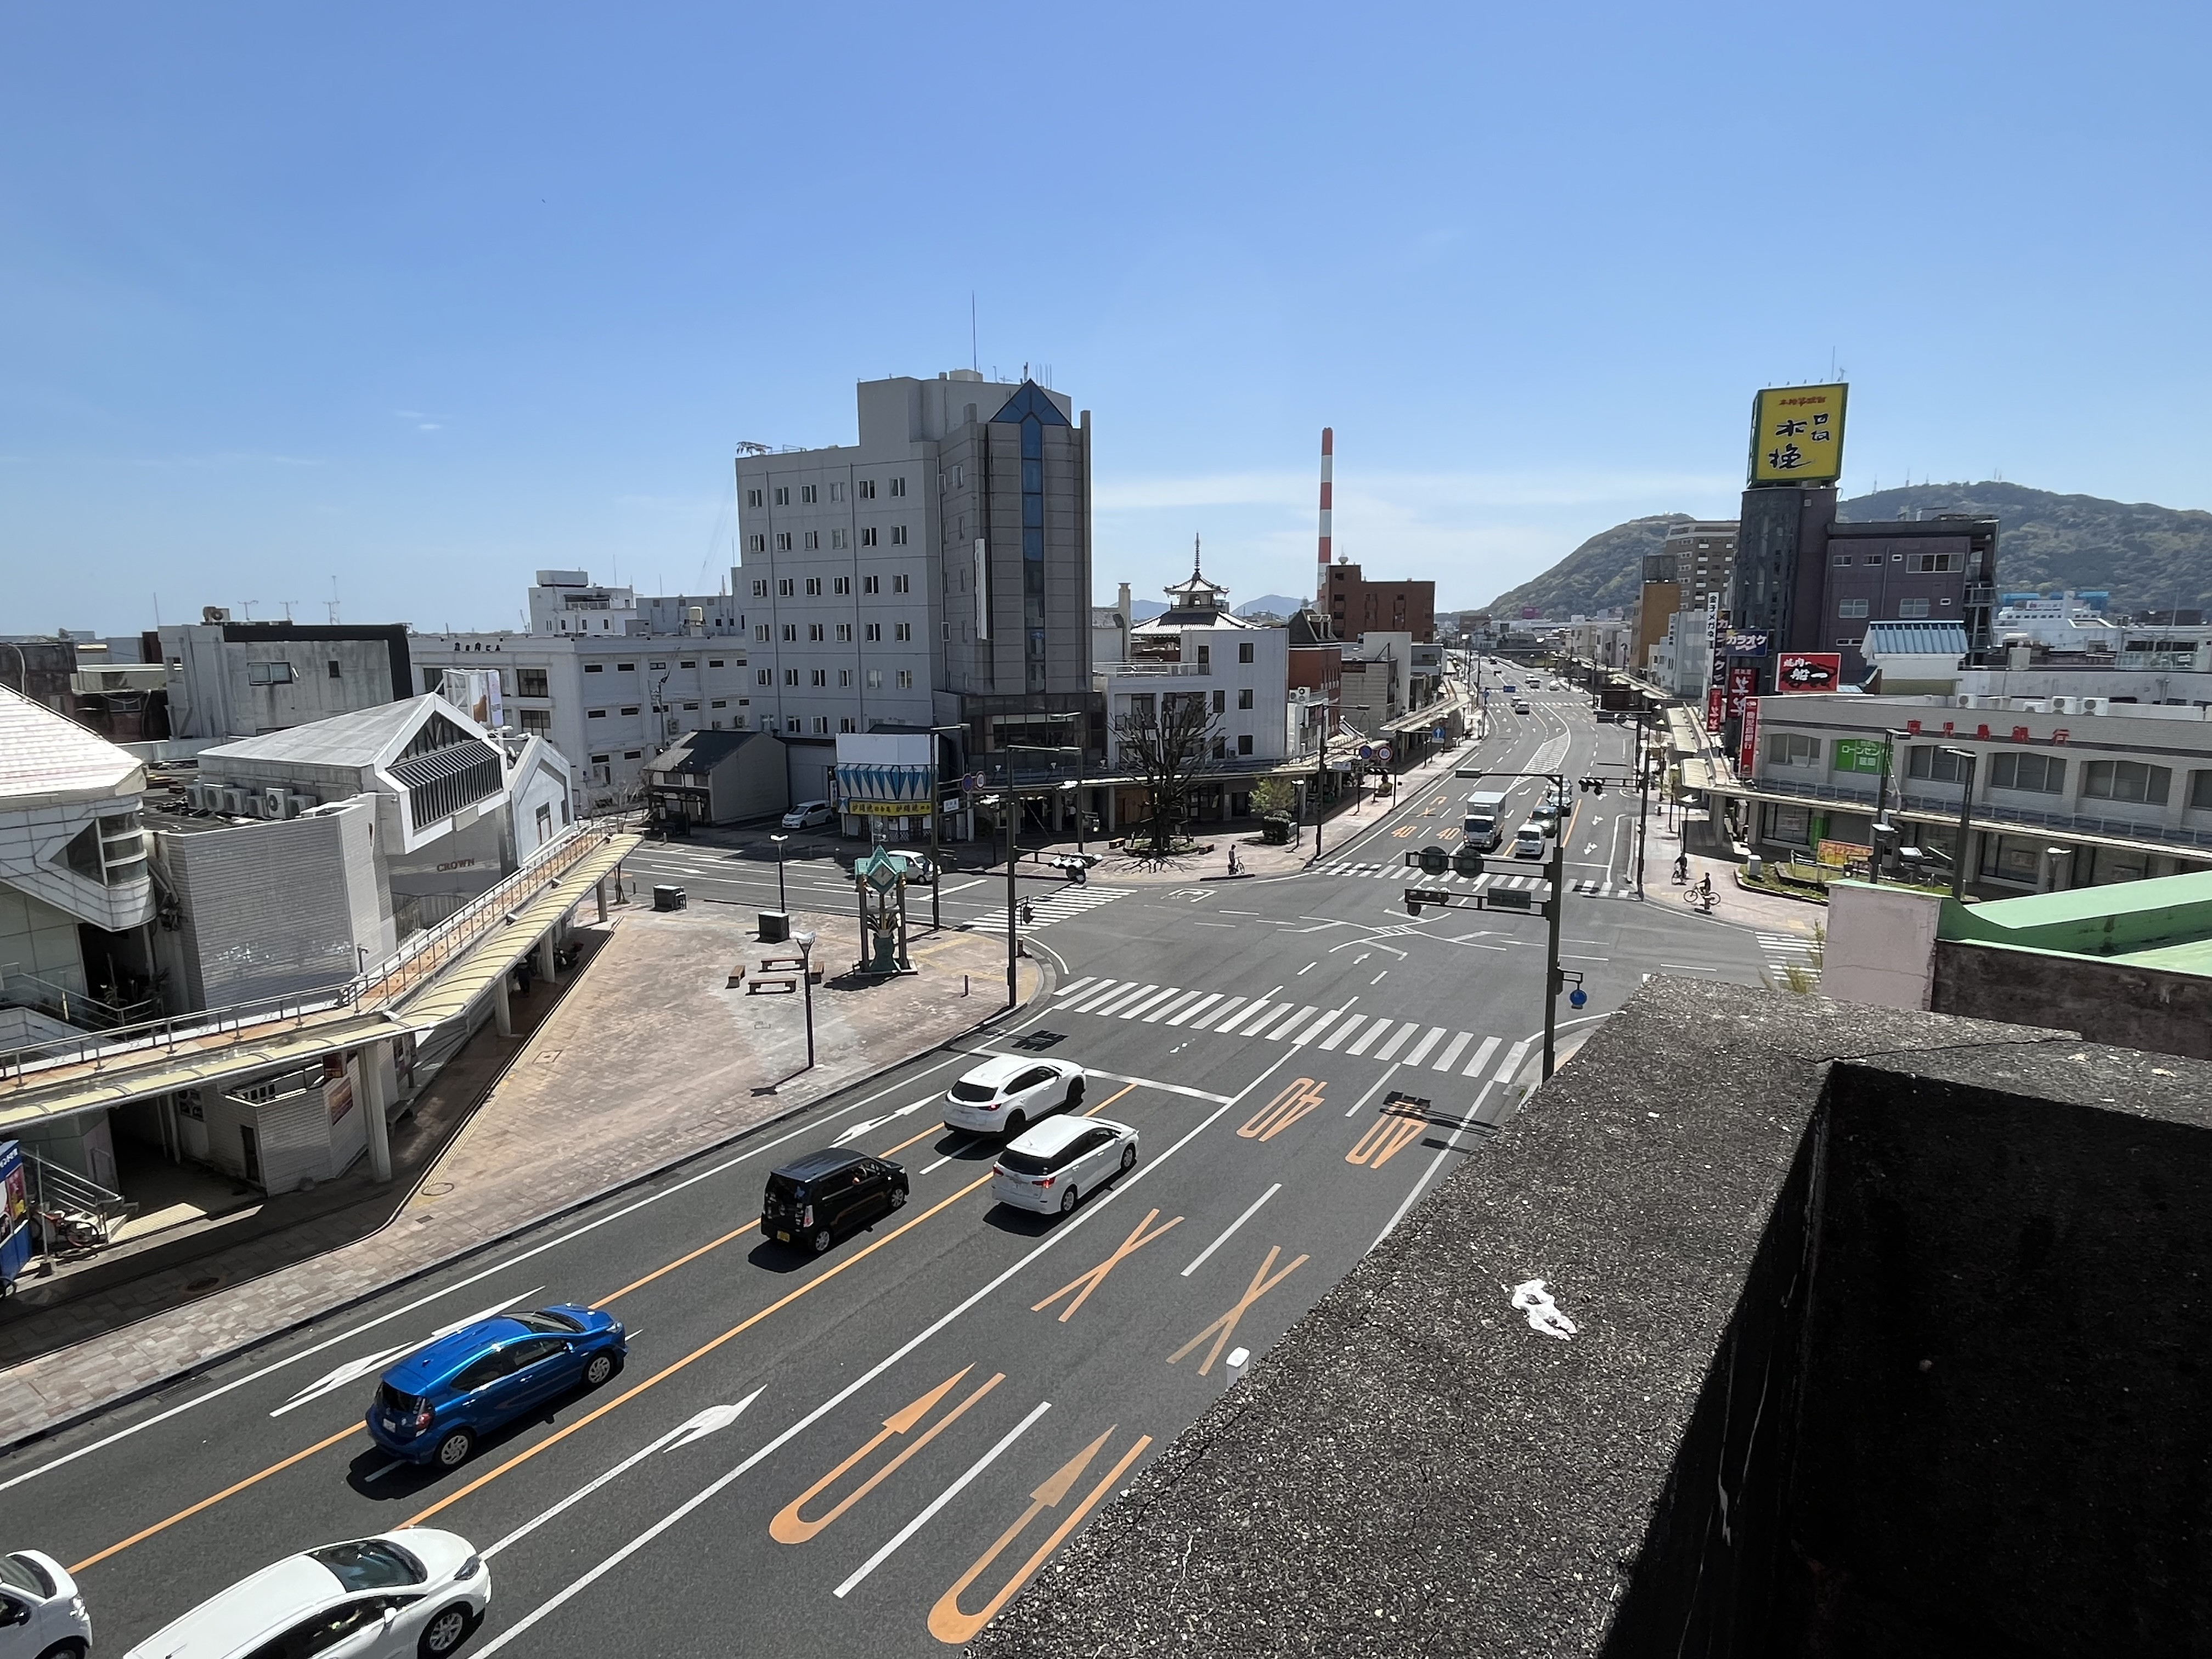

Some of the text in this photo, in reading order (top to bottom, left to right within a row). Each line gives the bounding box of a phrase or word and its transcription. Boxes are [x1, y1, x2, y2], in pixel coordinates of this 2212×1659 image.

[1811, 413, 1830, 441] 日向
[1726, 635, 1767, 645] カラオケ
[1744, 711, 1756, 749] 鹿児島銀行
[1391, 825, 1418, 838] 40
[1436, 827, 1460, 840] 40
[437, 858, 475, 872] CROWN
